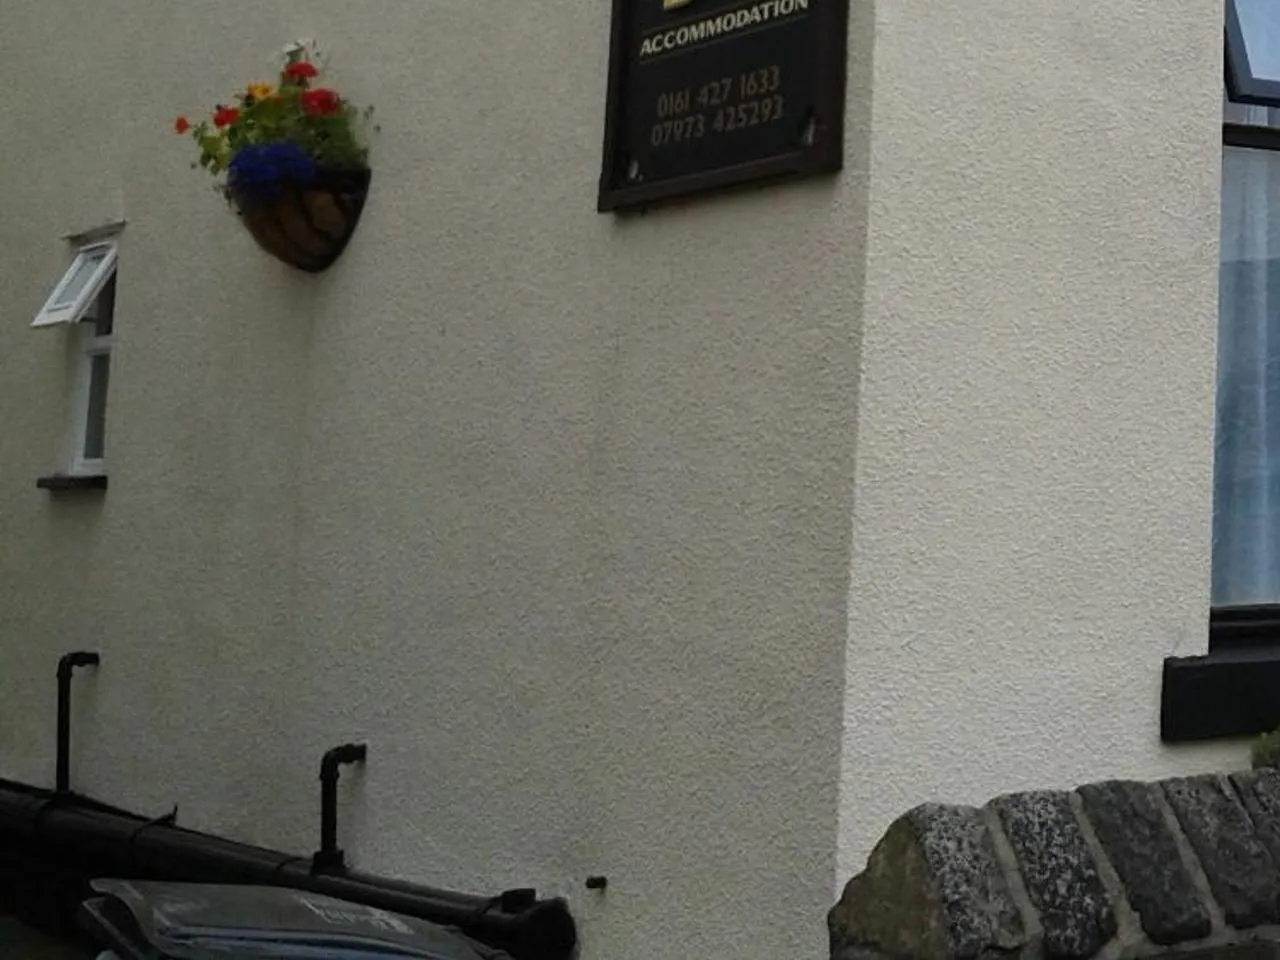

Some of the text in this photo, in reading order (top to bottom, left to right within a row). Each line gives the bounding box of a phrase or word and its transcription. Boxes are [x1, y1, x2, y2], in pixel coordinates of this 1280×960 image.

[657, 65, 781, 118] 0161 427 1633
[651, 94, 784, 147] 07973 425293
